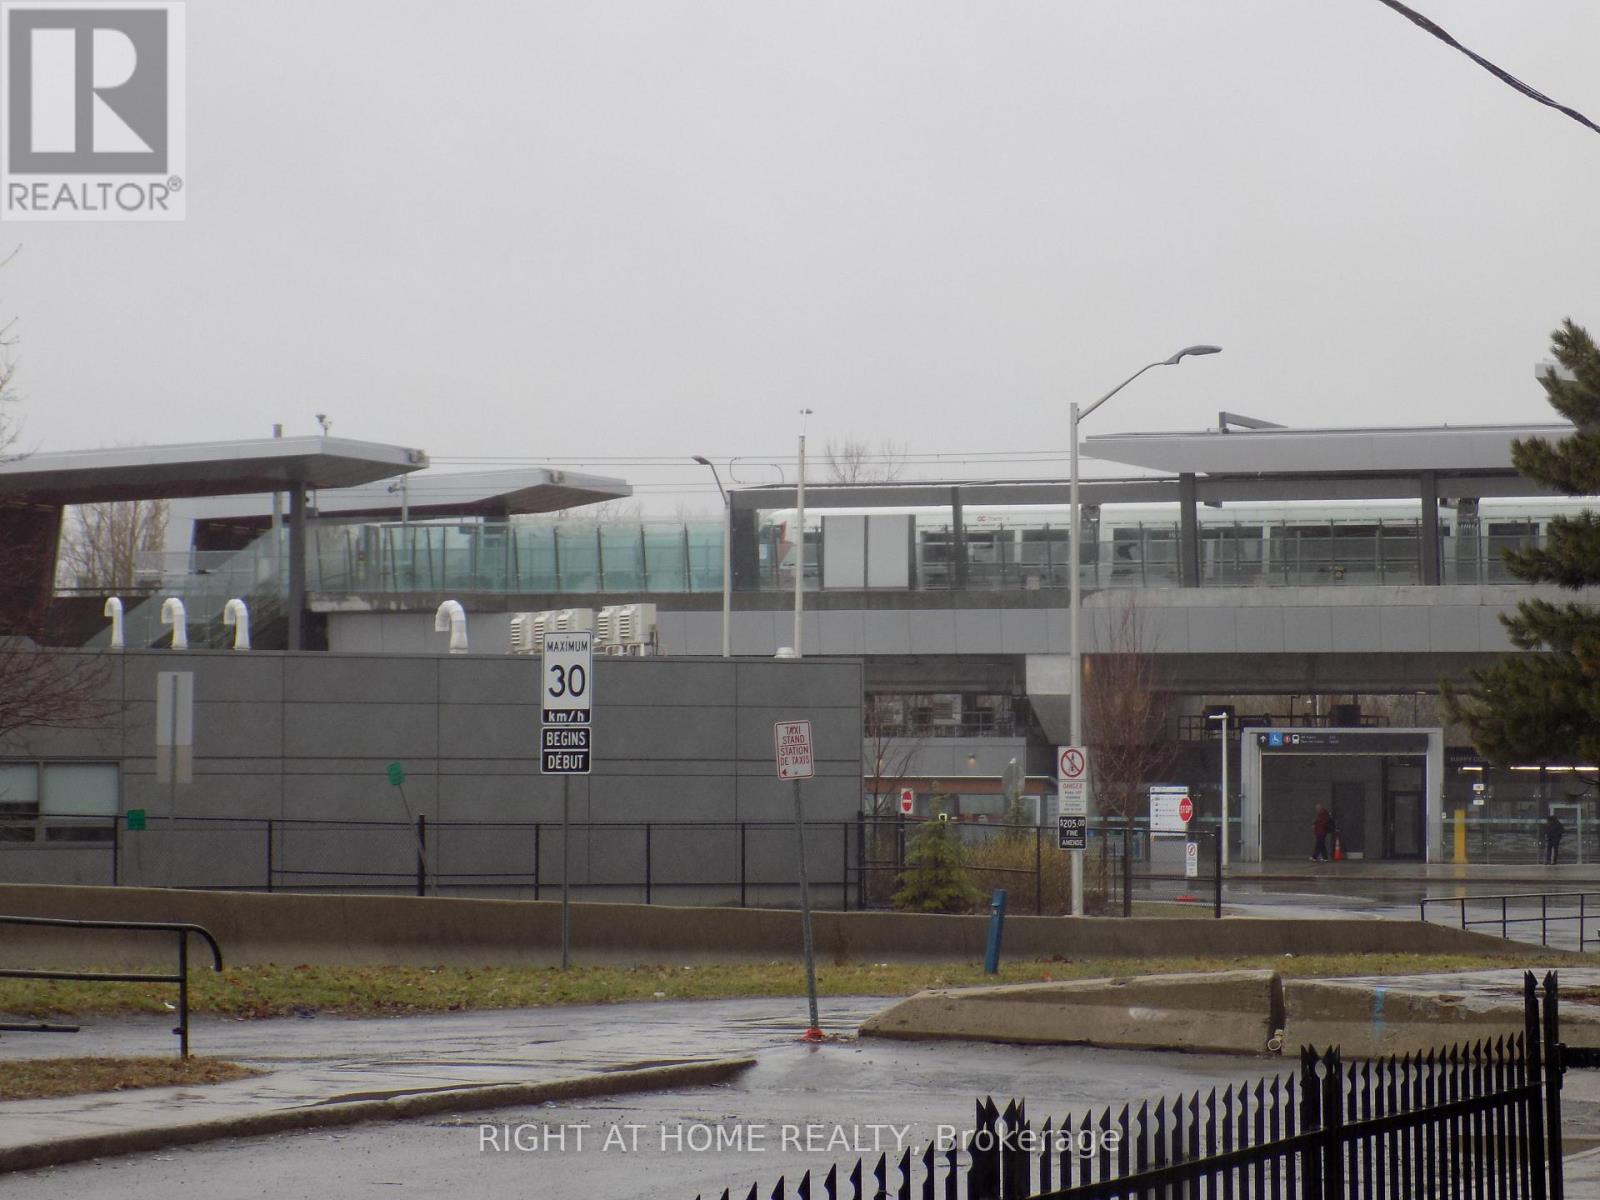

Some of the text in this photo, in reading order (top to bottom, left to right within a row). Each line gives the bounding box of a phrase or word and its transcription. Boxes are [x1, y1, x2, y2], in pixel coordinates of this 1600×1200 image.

[546, 641, 588, 652] MAXIMUM
[548, 664, 586, 698] 30
[548, 711, 585, 722] km/h
[785, 726, 801, 735] TAXI
[546, 731, 586, 746] BEGINS
[782, 735, 805, 745] STAND
[780, 746, 809, 756] STATION
[548, 752, 584, 769] DÉBUT
[780, 755, 810, 766] DE TAXIS
[1180, 805, 1192, 814] STOP
